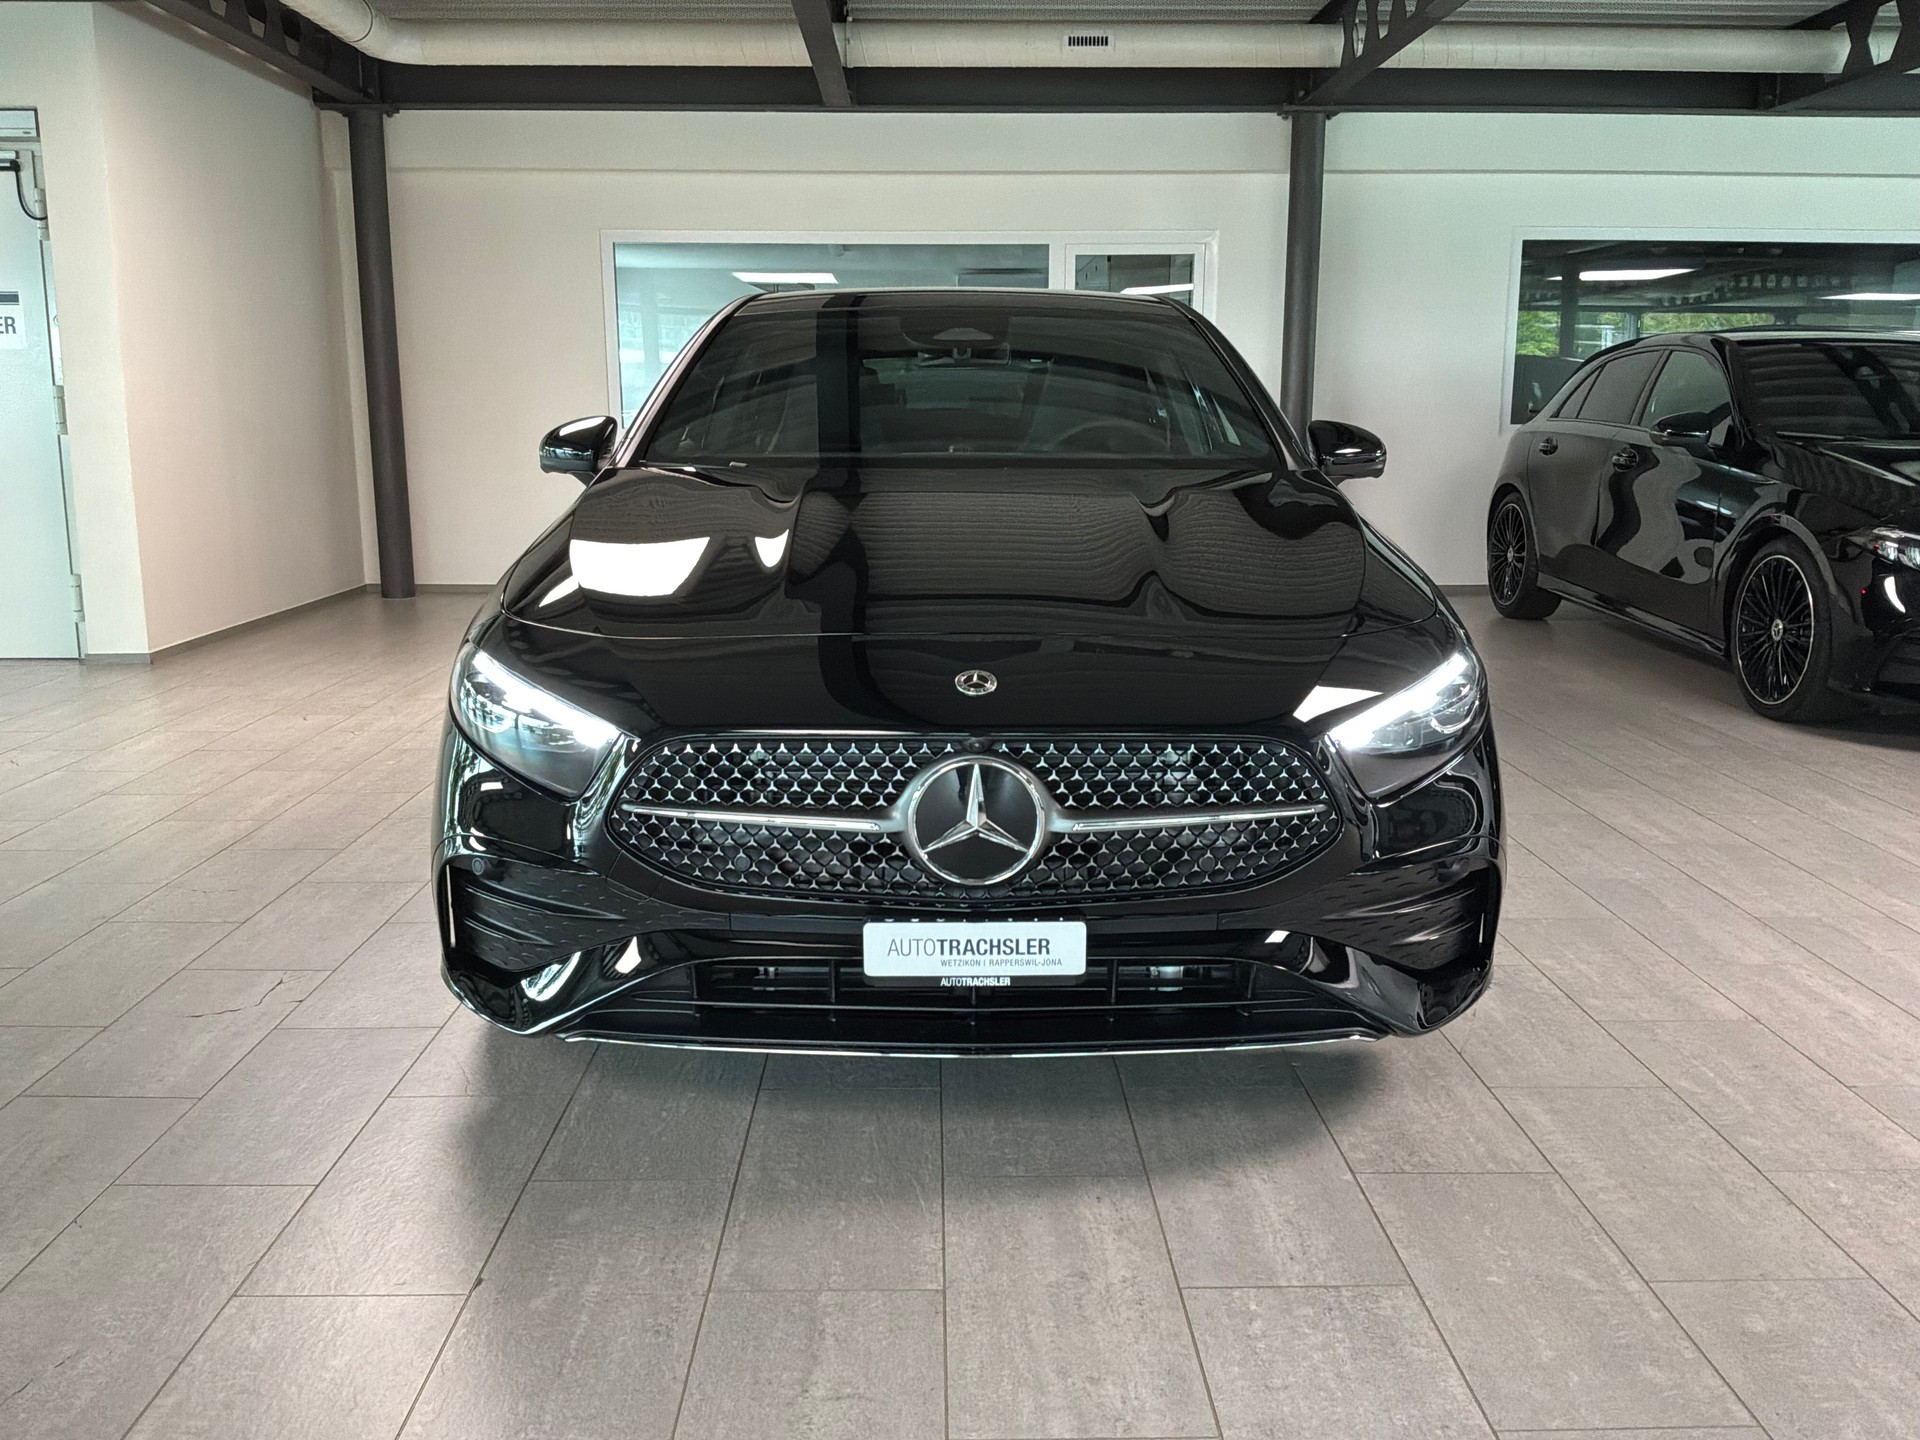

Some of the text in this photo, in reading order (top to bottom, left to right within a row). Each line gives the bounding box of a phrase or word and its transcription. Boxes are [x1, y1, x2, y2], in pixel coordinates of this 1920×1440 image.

[887, 938, 1051, 957] AUTOTRACHSLER
[940, 958, 981, 968] WETZIKON
[988, 958, 1062, 967] RAPPERSWIL-JONA
[940, 977, 1011, 987] AUTOTRACHSLER
